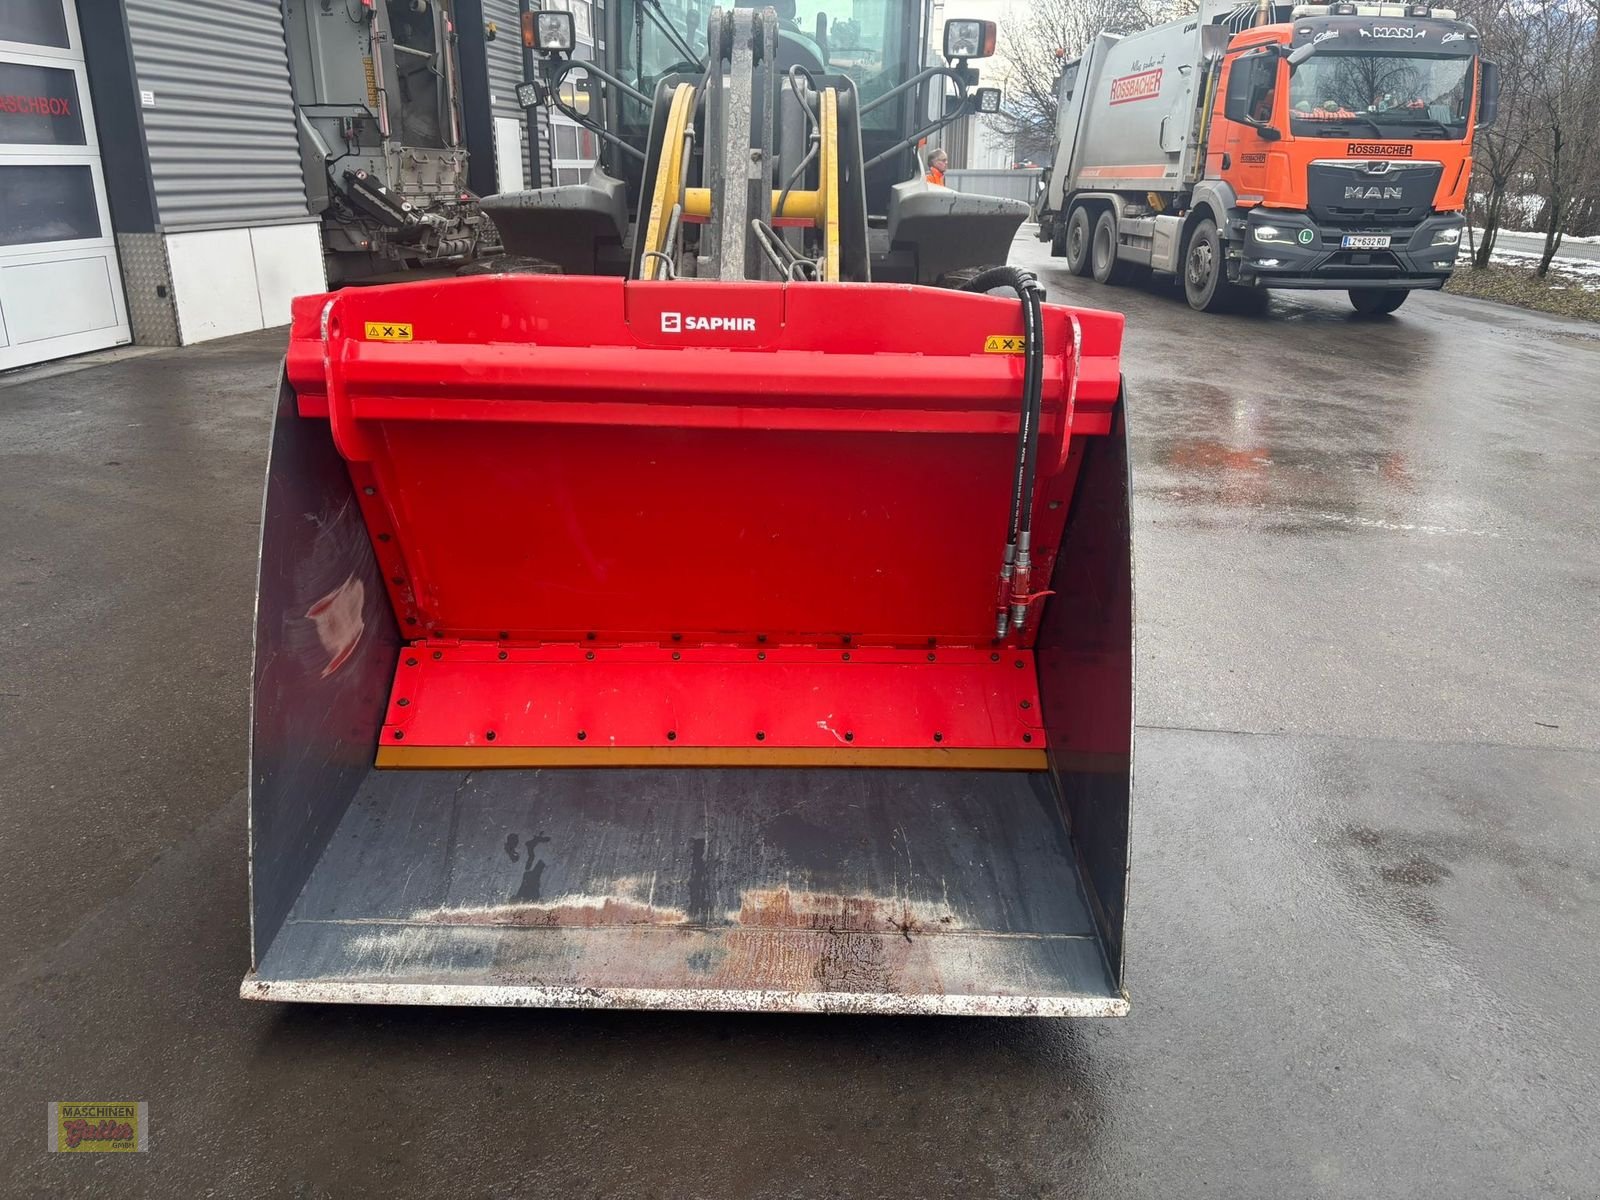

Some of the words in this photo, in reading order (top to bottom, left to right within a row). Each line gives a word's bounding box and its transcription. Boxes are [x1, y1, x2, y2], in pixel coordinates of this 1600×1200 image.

[1373, 26, 1414, 39] MAN
[1347, 143, 1413, 156] ROSSBACHER
[1344, 186, 1402, 199] MAN
[685, 316, 756, 331] SAPHIR
